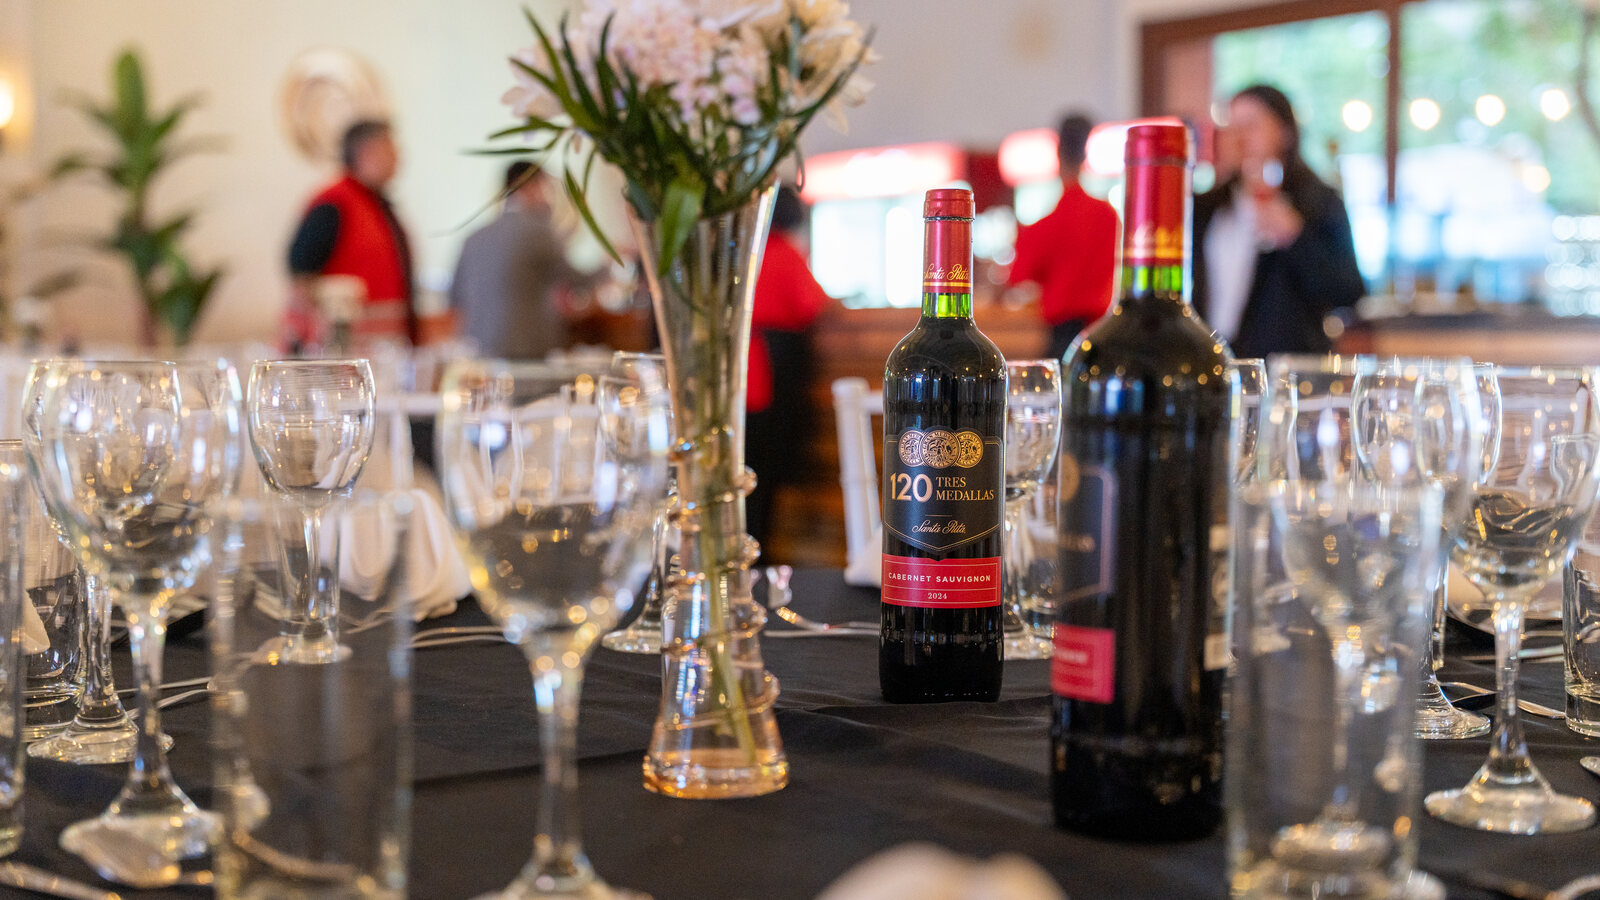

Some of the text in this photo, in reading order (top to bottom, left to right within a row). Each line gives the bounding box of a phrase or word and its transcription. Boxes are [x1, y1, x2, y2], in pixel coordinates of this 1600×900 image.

[890, 472, 933, 503] 120
[935, 476, 967, 488] TRES
[935, 489, 995, 501] MEDALLAS
[911, 519, 941, 533] Santa
[888, 572, 991, 583] CABERNET SAUVIGNON
[927, 592, 947, 600] 2024
